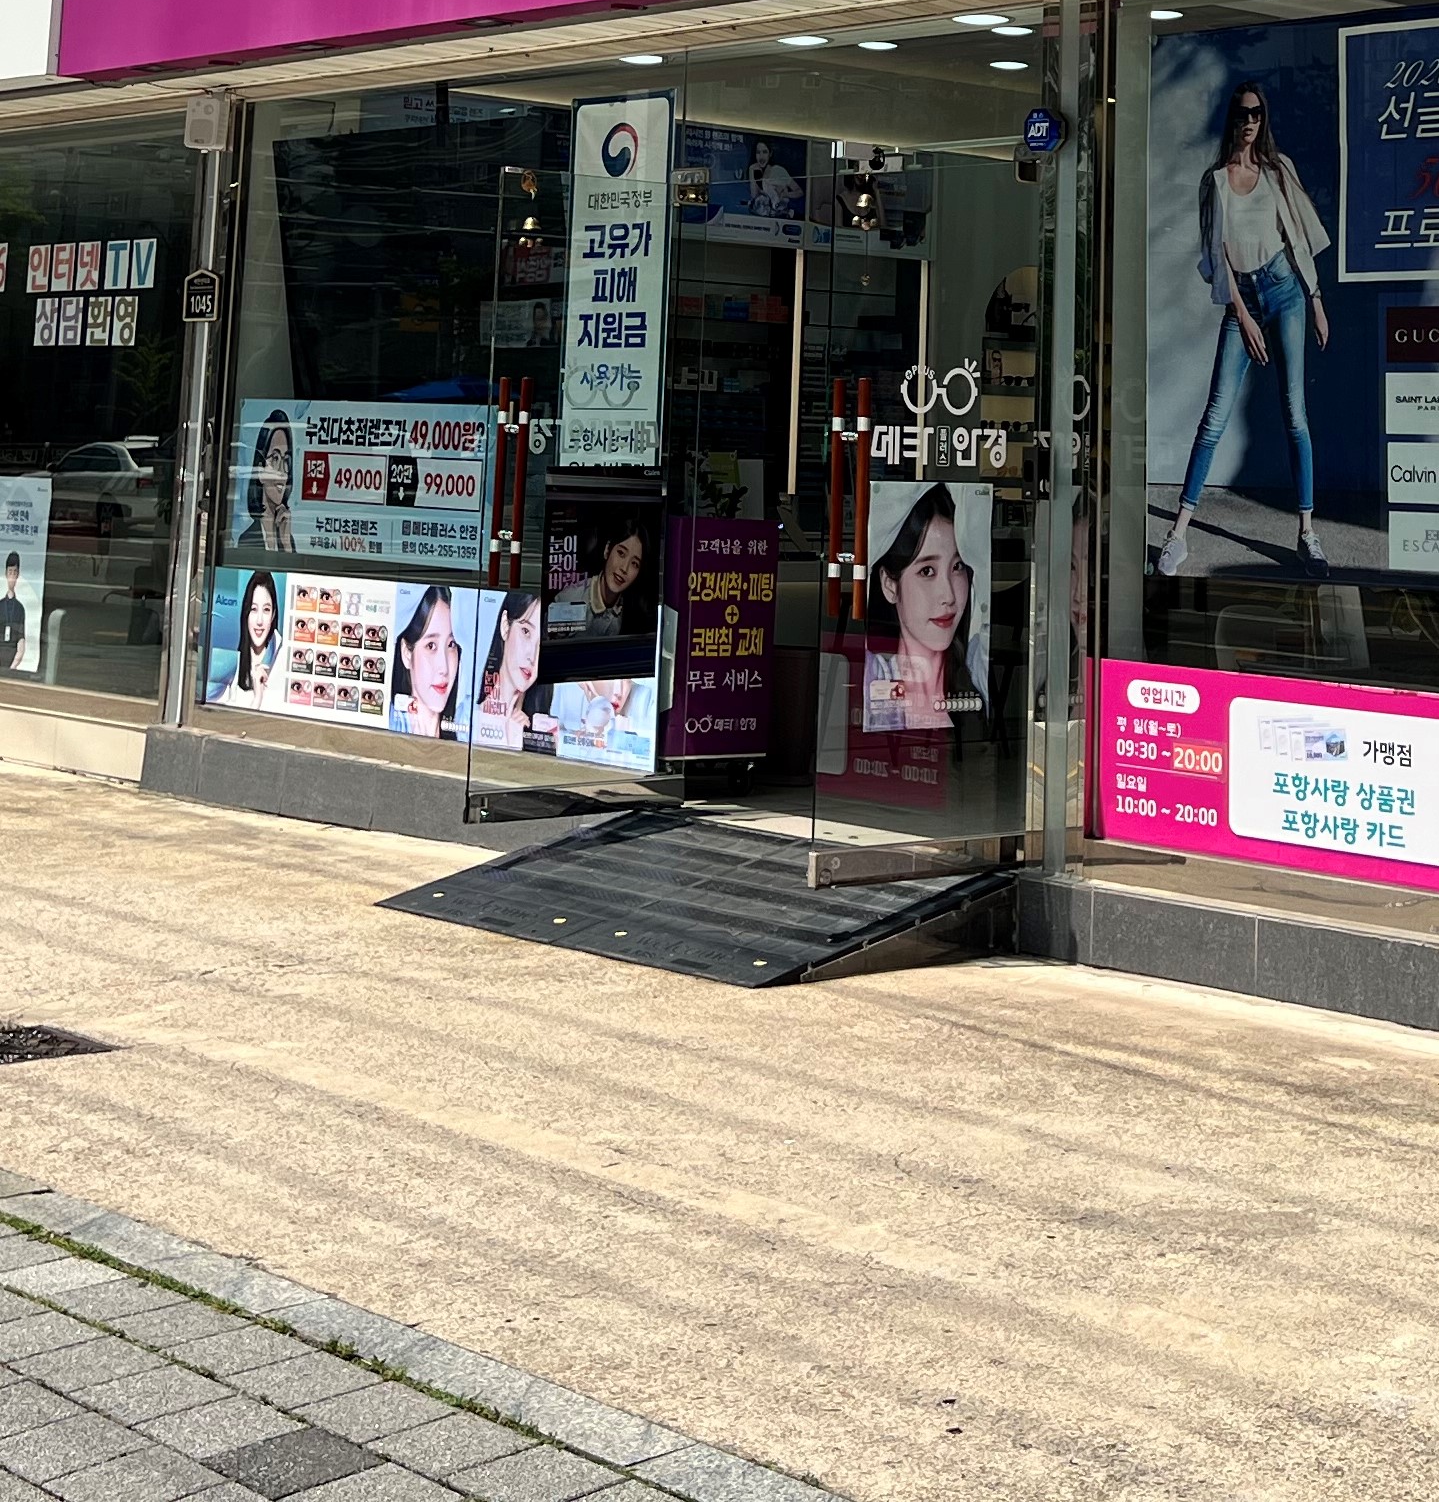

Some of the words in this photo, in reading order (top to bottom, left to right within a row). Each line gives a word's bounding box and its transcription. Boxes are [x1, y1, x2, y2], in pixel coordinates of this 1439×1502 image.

[1028, 123, 1049, 138] ADT
[588, 190, 652, 209] 대한민국정부
[582, 221, 652, 259] 고유가
[591, 268, 637, 303] 피해
[190, 295, 212, 313] 1045
[577, 311, 648, 349] 지원금
[580, 363, 643, 391] 사용가능
[1395, 396, 1423, 404] SAINT
[870, 425, 935, 465] 메타
[952, 426, 1006, 468] 안경
[334, 467, 382, 491] 49,000
[424, 472, 476, 497] 99,000
[1390, 465, 1437, 484] Calvin
[315, 516, 378, 536] 누진다초점렌즈
[459, 524, 478, 541] 안경
[339, 535, 366, 552] 100%
[418, 543, 477, 559] 054-255-1359
[549, 535, 578, 553] 눈이
[697, 539, 743, 556] 고객님을
[747, 540, 768, 556] 위한
[548, 554, 578, 572] 맞아
[215, 594, 238, 607] Alcon
[690, 626, 733, 657] 코받침
[736, 627, 764, 656] 교체
[687, 670, 716, 692] 무료
[722, 669, 763, 692] 서비스
[1140, 685, 1187, 707] 영업시간
[1116, 738, 1158, 761] 09:30
[1173, 746, 1223, 773] 20:00
[1362, 739, 1412, 767] 가맹점
[1115, 773, 1147, 792] 일요일
[1272, 772, 1350, 807] 포항사랑
[1355, 782, 1416, 816] 상품권
[1115, 795, 1157, 818] 10:00
[1174, 803, 1219, 827] 20:00
[1281, 809, 1360, 845] 포항사랑
[1366, 821, 1406, 848] 카드
